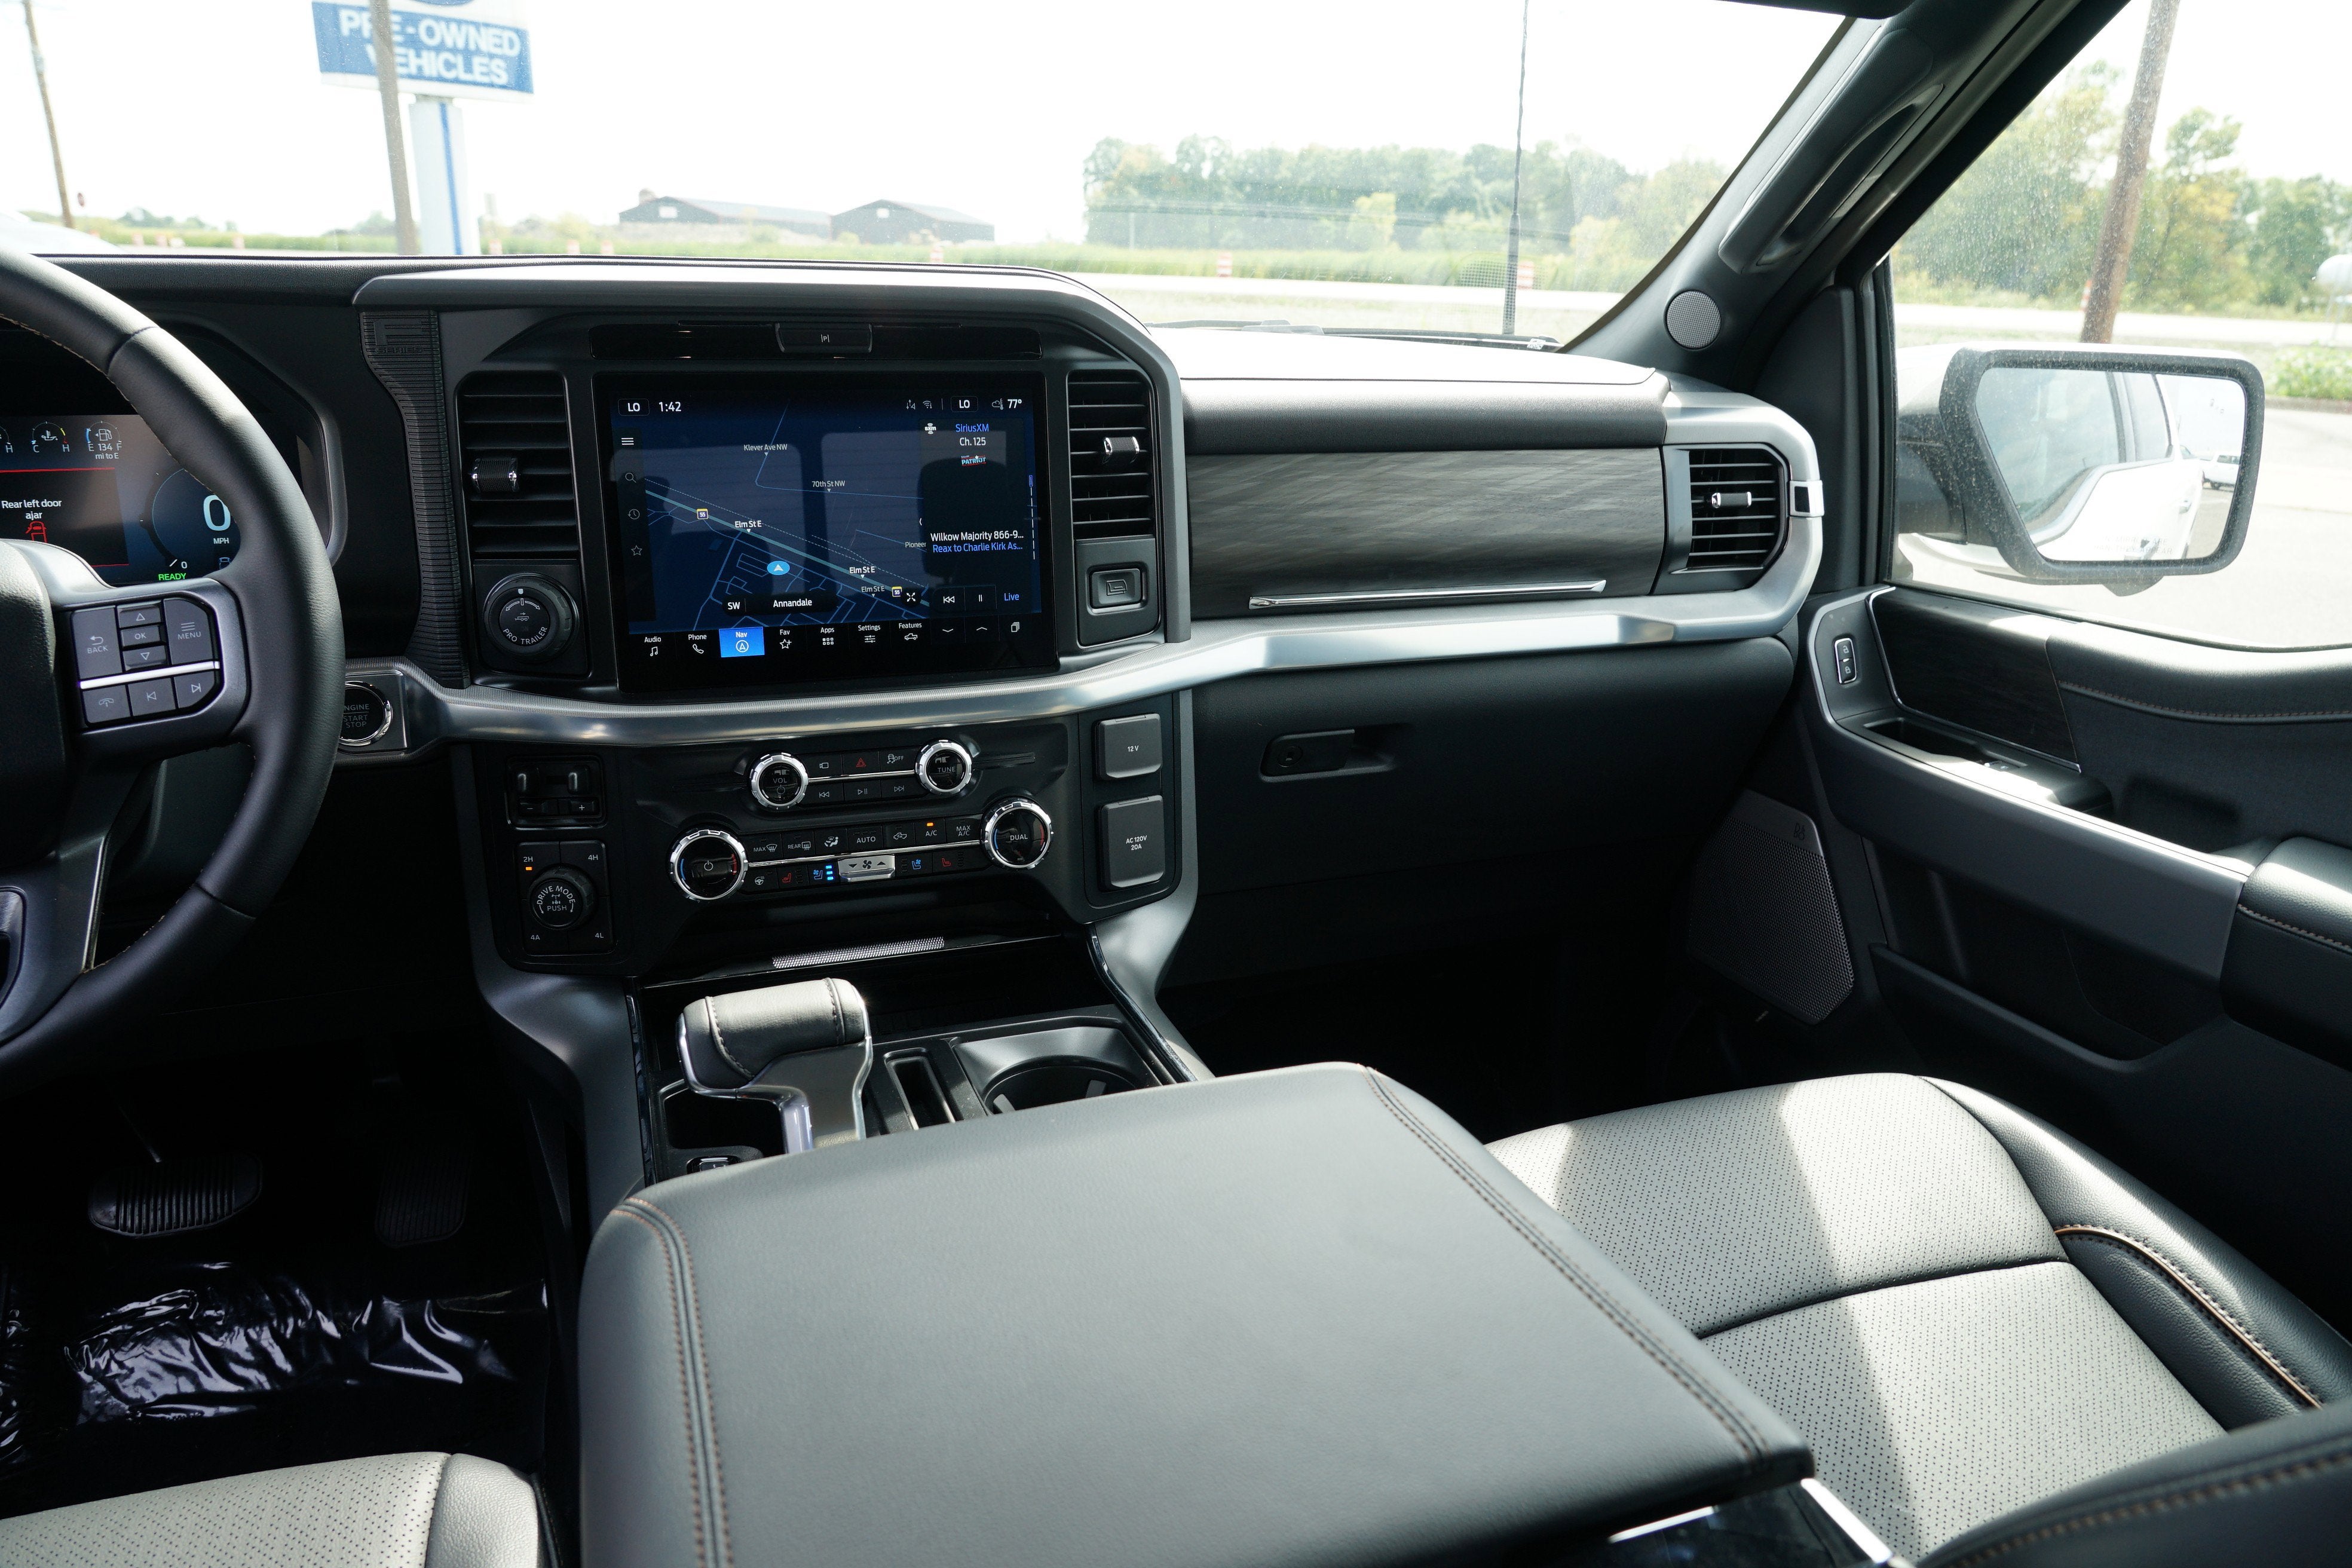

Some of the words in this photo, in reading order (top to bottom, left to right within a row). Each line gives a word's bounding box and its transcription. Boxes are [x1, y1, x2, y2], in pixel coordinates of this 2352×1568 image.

[627, 403, 640, 412] LO
[659, 402, 681, 412] 1:42
[959, 400, 970, 409] LO
[1007, 399, 1022, 409] 77°
[956, 424, 989, 432] SiriusXM
[960, 437, 972, 446] Ch.
[973, 437, 986, 446] 125
[26, 512, 42, 520] ajar
[203, 495, 231, 531] 0
[931, 532, 959, 541] Wilkow
[961, 531, 992, 541] Majority
[963, 543, 990, 552] Charlie
[773, 598, 812, 608] Annandale
[178, 631, 201, 639] MENU
[503, 628, 517, 642] PRO
[520, 627, 547, 645] TRAILER
[87, 645, 108, 654] BACK
[537, 886, 554, 905] DRIVE
[555, 886, 576, 904] MODE
